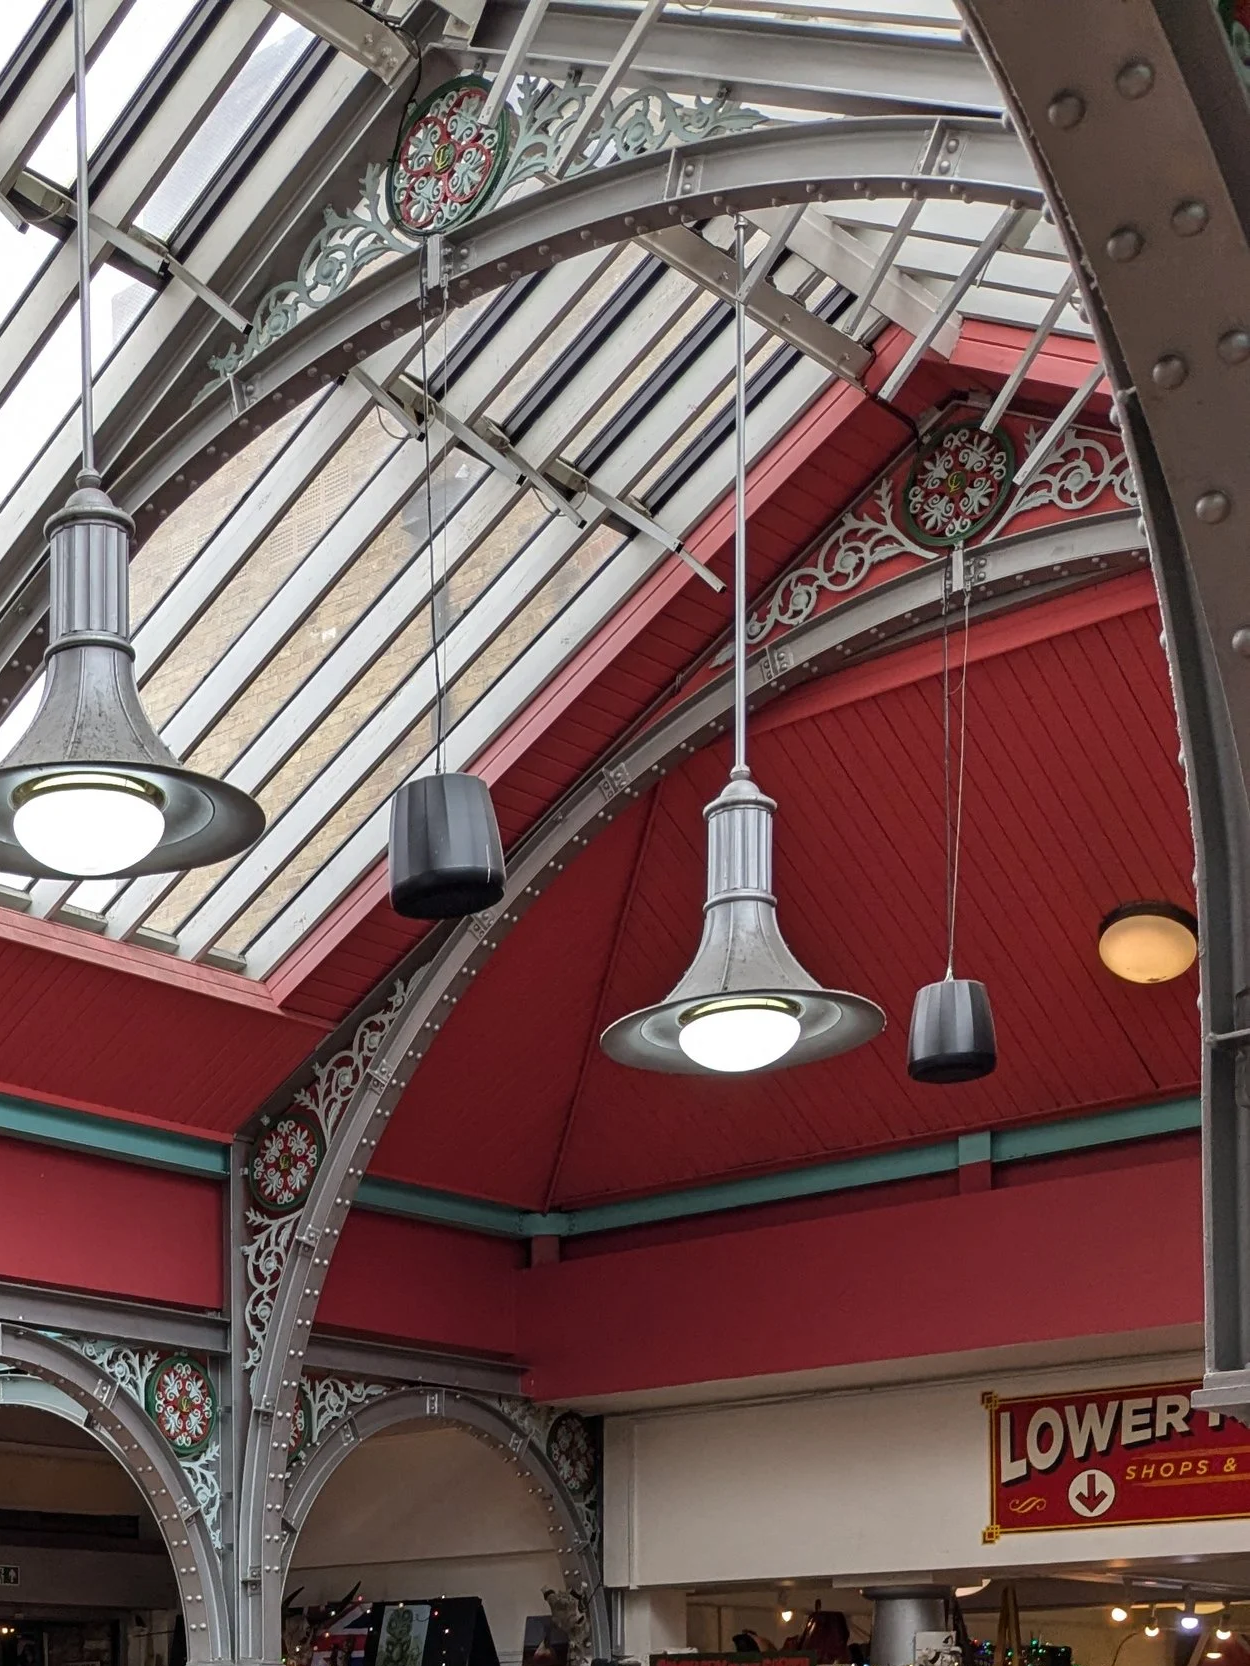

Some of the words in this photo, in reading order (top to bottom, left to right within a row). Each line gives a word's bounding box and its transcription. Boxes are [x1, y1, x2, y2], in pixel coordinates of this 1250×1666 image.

[1001, 1395, 1191, 1485] LOWER
[1125, 1460, 1209, 1480] SHOPS
[1223, 1458, 1238, 1472] &
